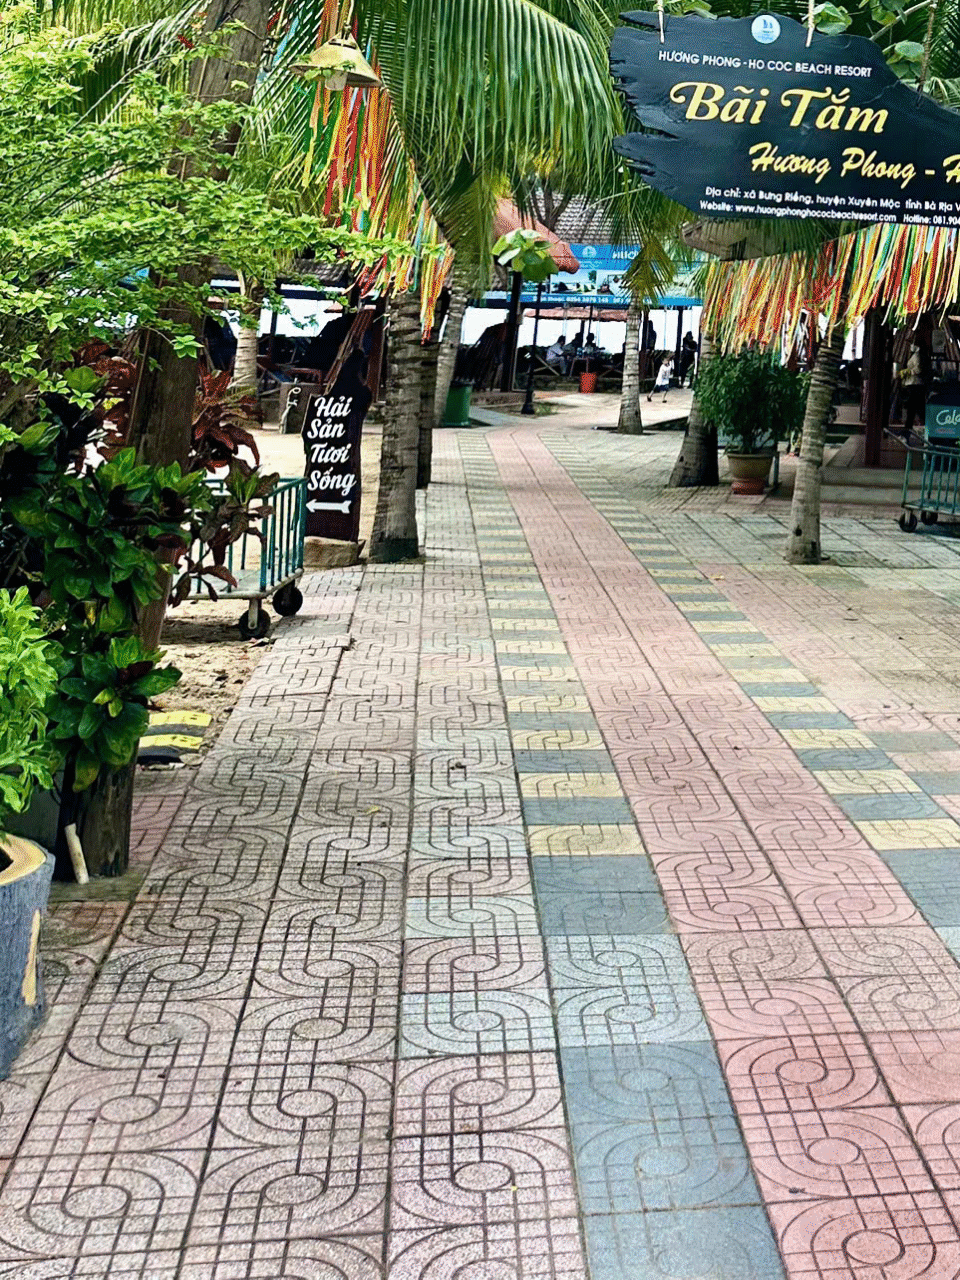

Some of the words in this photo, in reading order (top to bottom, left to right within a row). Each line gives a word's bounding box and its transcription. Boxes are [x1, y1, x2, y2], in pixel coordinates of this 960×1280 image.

[658, 50, 700, 65] HƯƠNG
[702, 55, 742, 68] PHONG
[748, 59, 765, 71] HO
[767, 60, 793, 72] COC
[795, 62, 832, 75] BEACH
[834, 65, 872, 78] RESORT
[669, 81, 770, 125] Bãi
[780, 86, 889, 134] Tắm
[749, 142, 831, 184] Hương
[840, 147, 917, 189] Phong
[700, 200, 734, 212] Website:
[903, 213, 932, 224] Hotline:
[705, 186, 722, 197] Địa
[724, 187, 741, 199] chỉ:
[758, 190, 783, 203] Bưng
[816, 194, 846, 207] huyện
[848, 196, 878, 209] Xuyên
[880, 198, 901, 209] Mộc
[905, 198, 922, 210] tỉnh
[924, 200, 937, 210] Bà
[938, 201, 953, 212] Rịa
[314, 395, 353, 418] Hải
[307, 417, 345, 439] Sản
[310, 442, 352, 464] Tươi
[307, 466, 358, 496] Sống
